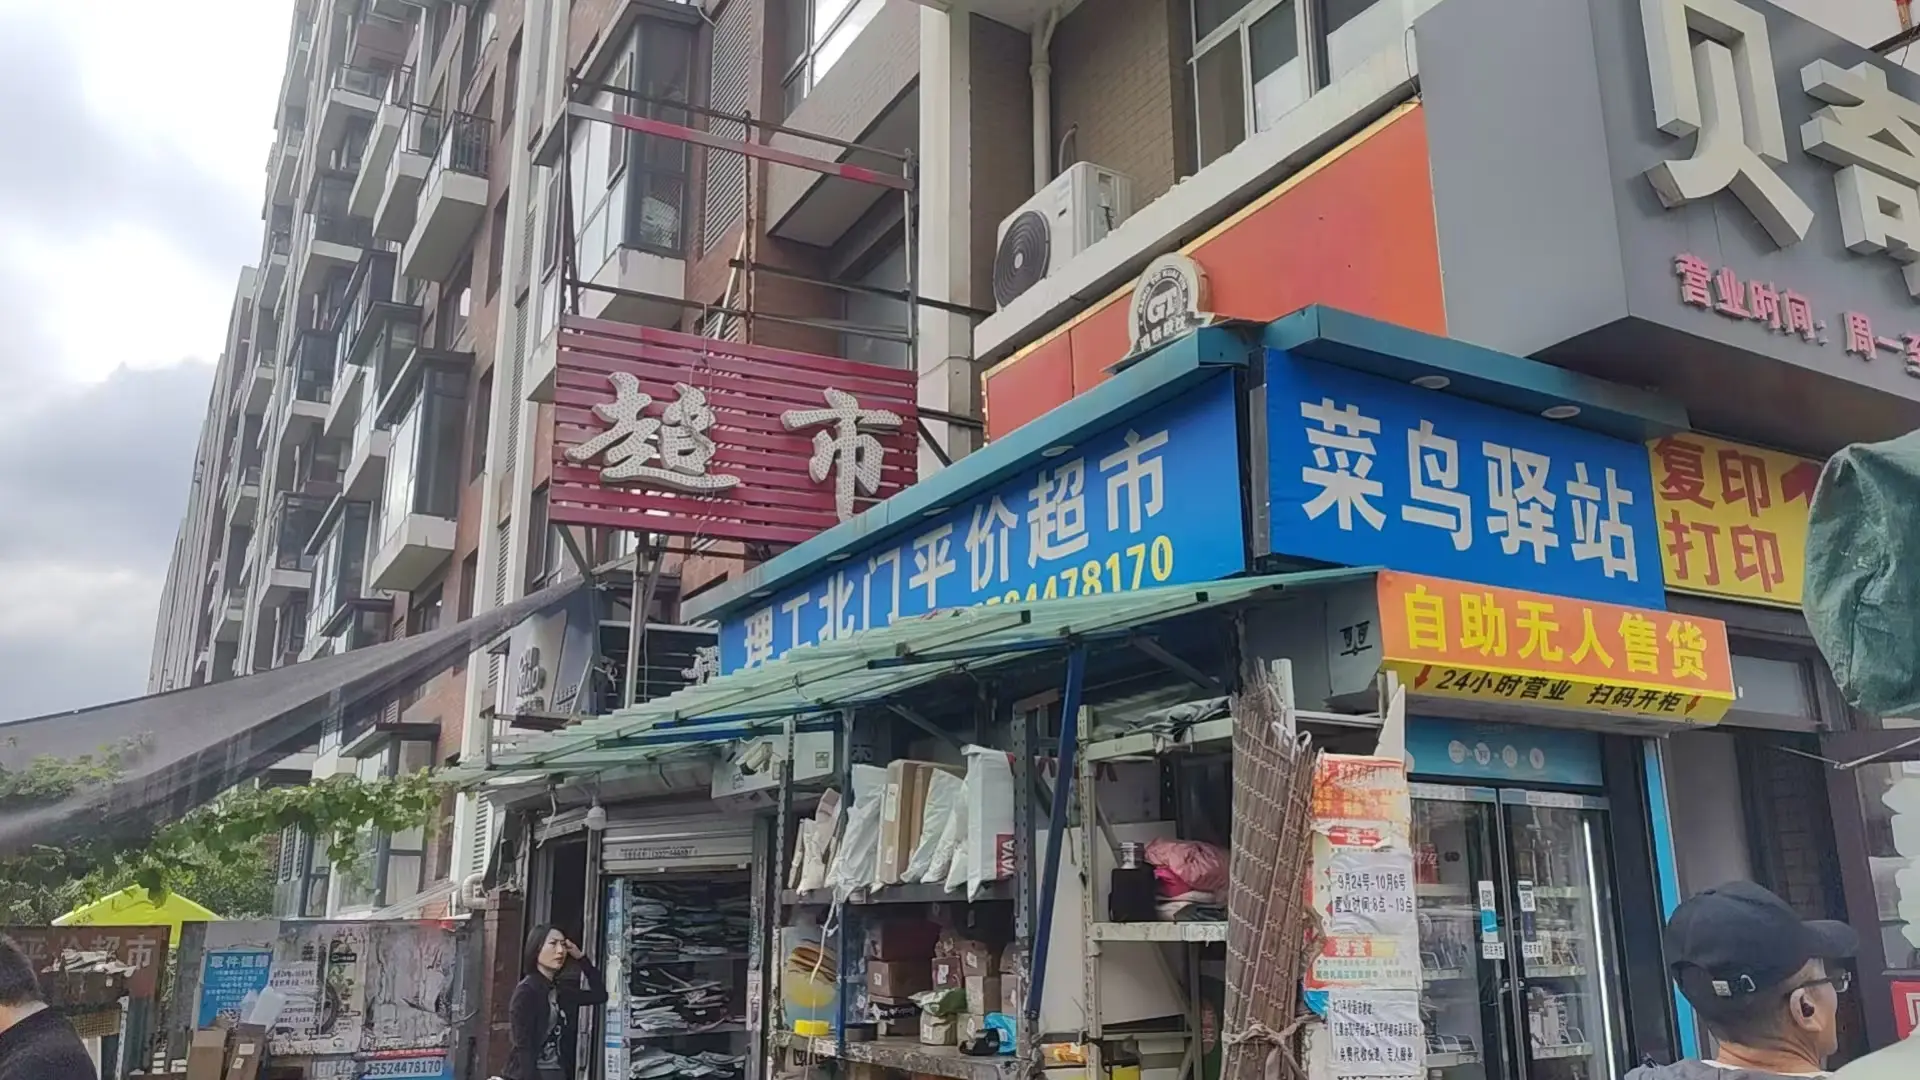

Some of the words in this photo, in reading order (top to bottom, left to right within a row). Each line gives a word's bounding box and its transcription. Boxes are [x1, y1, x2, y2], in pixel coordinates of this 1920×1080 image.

[565, 370, 903, 524] 超市
[1300, 397, 1639, 583] 菜鸟驿站
[1654, 436, 1771, 518] 复印
[743, 428, 1170, 663] 理工北门平价超市
[1663, 508, 1785, 593] 打印
[1403, 584, 1708, 681] 自助无人售货
[1435, 668, 1573, 702] 24小时营业
[1586, 682, 1685, 713] 扫码开柜
[1337, 873, 1406, 892] 9月24号-10月6号
